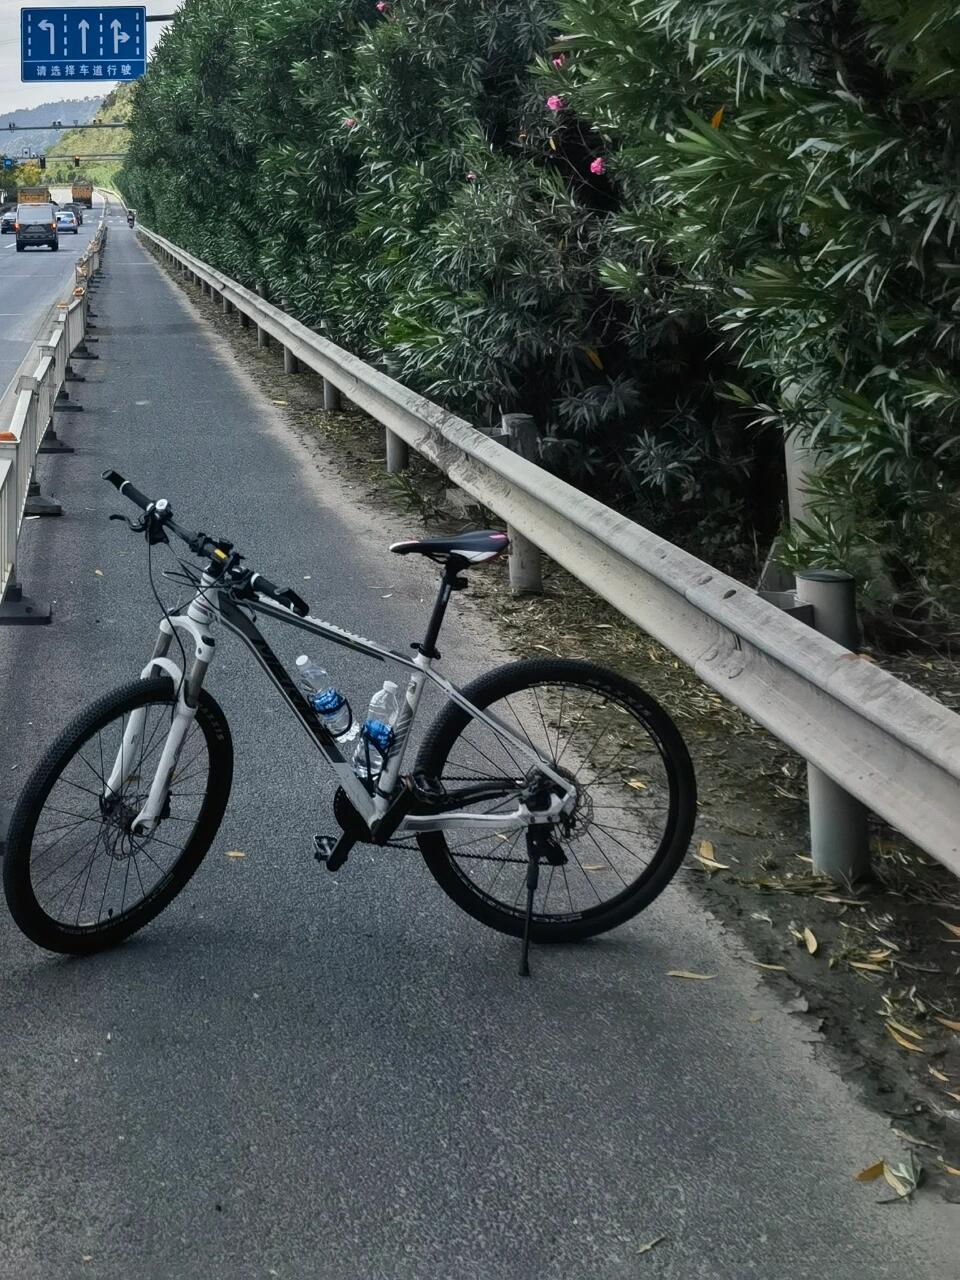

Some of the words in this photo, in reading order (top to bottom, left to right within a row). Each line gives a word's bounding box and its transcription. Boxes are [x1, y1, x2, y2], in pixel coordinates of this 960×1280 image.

[36, 63, 132, 78] 请选择车道行驶
